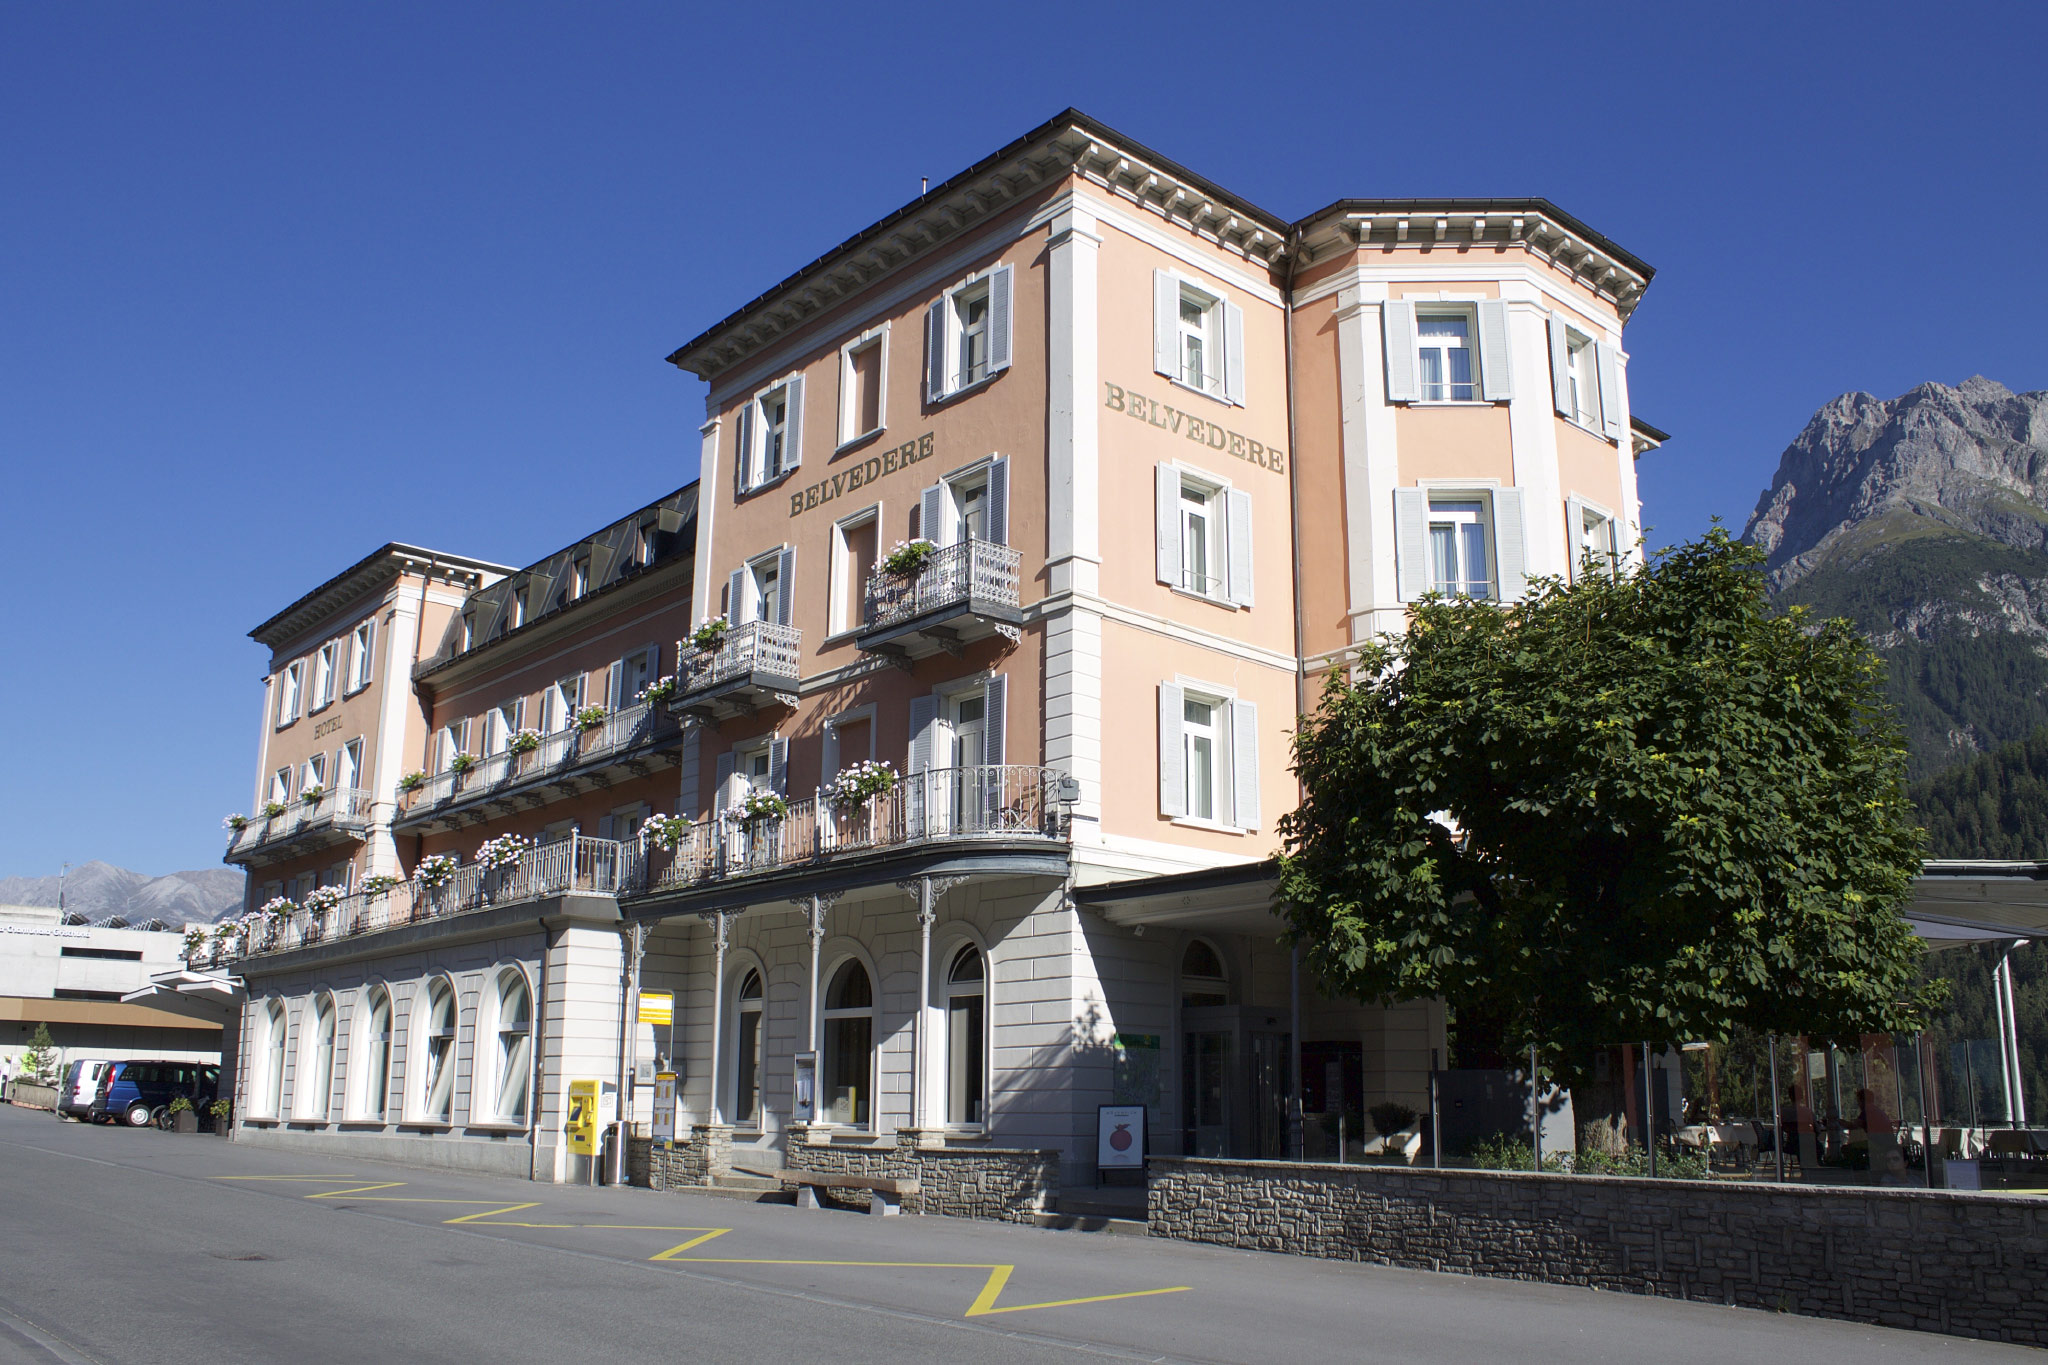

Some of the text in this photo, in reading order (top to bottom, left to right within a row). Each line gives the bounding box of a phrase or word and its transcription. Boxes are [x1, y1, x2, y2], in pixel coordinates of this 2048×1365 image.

[1104, 381, 1285, 475] BELVEDERE
[789, 431, 934, 518] BELVEDERE
[314, 714, 343, 740] HOTEL
